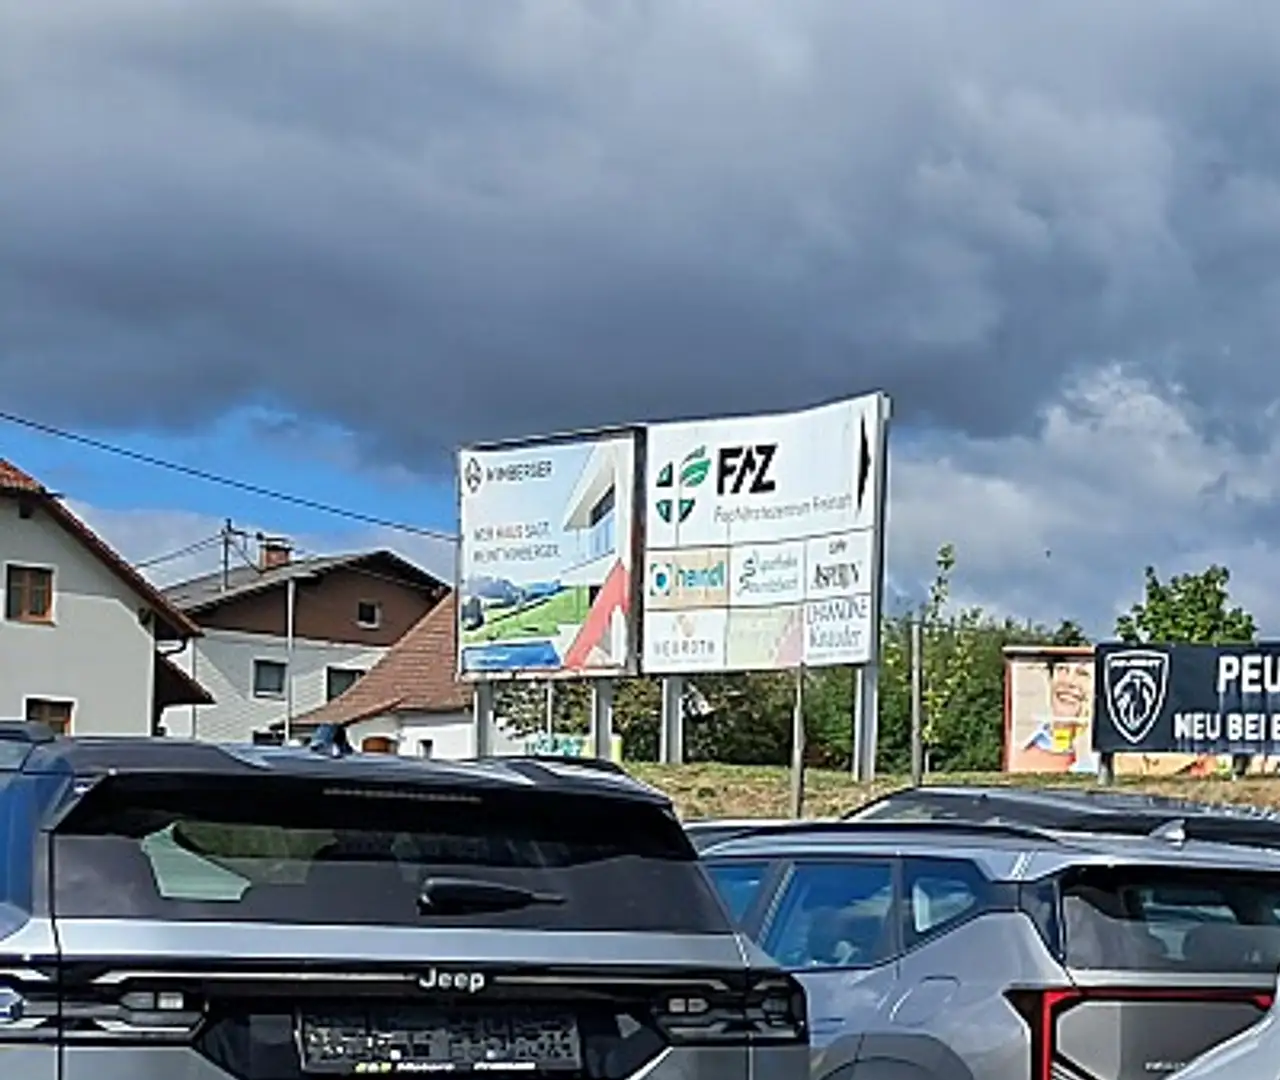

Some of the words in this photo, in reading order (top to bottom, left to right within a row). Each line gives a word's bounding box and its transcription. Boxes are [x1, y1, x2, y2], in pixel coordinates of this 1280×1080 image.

[1174, 712, 1221, 741] NEU
[1226, 713, 1267, 742] BEI
[419, 967, 485, 993] Jeep
